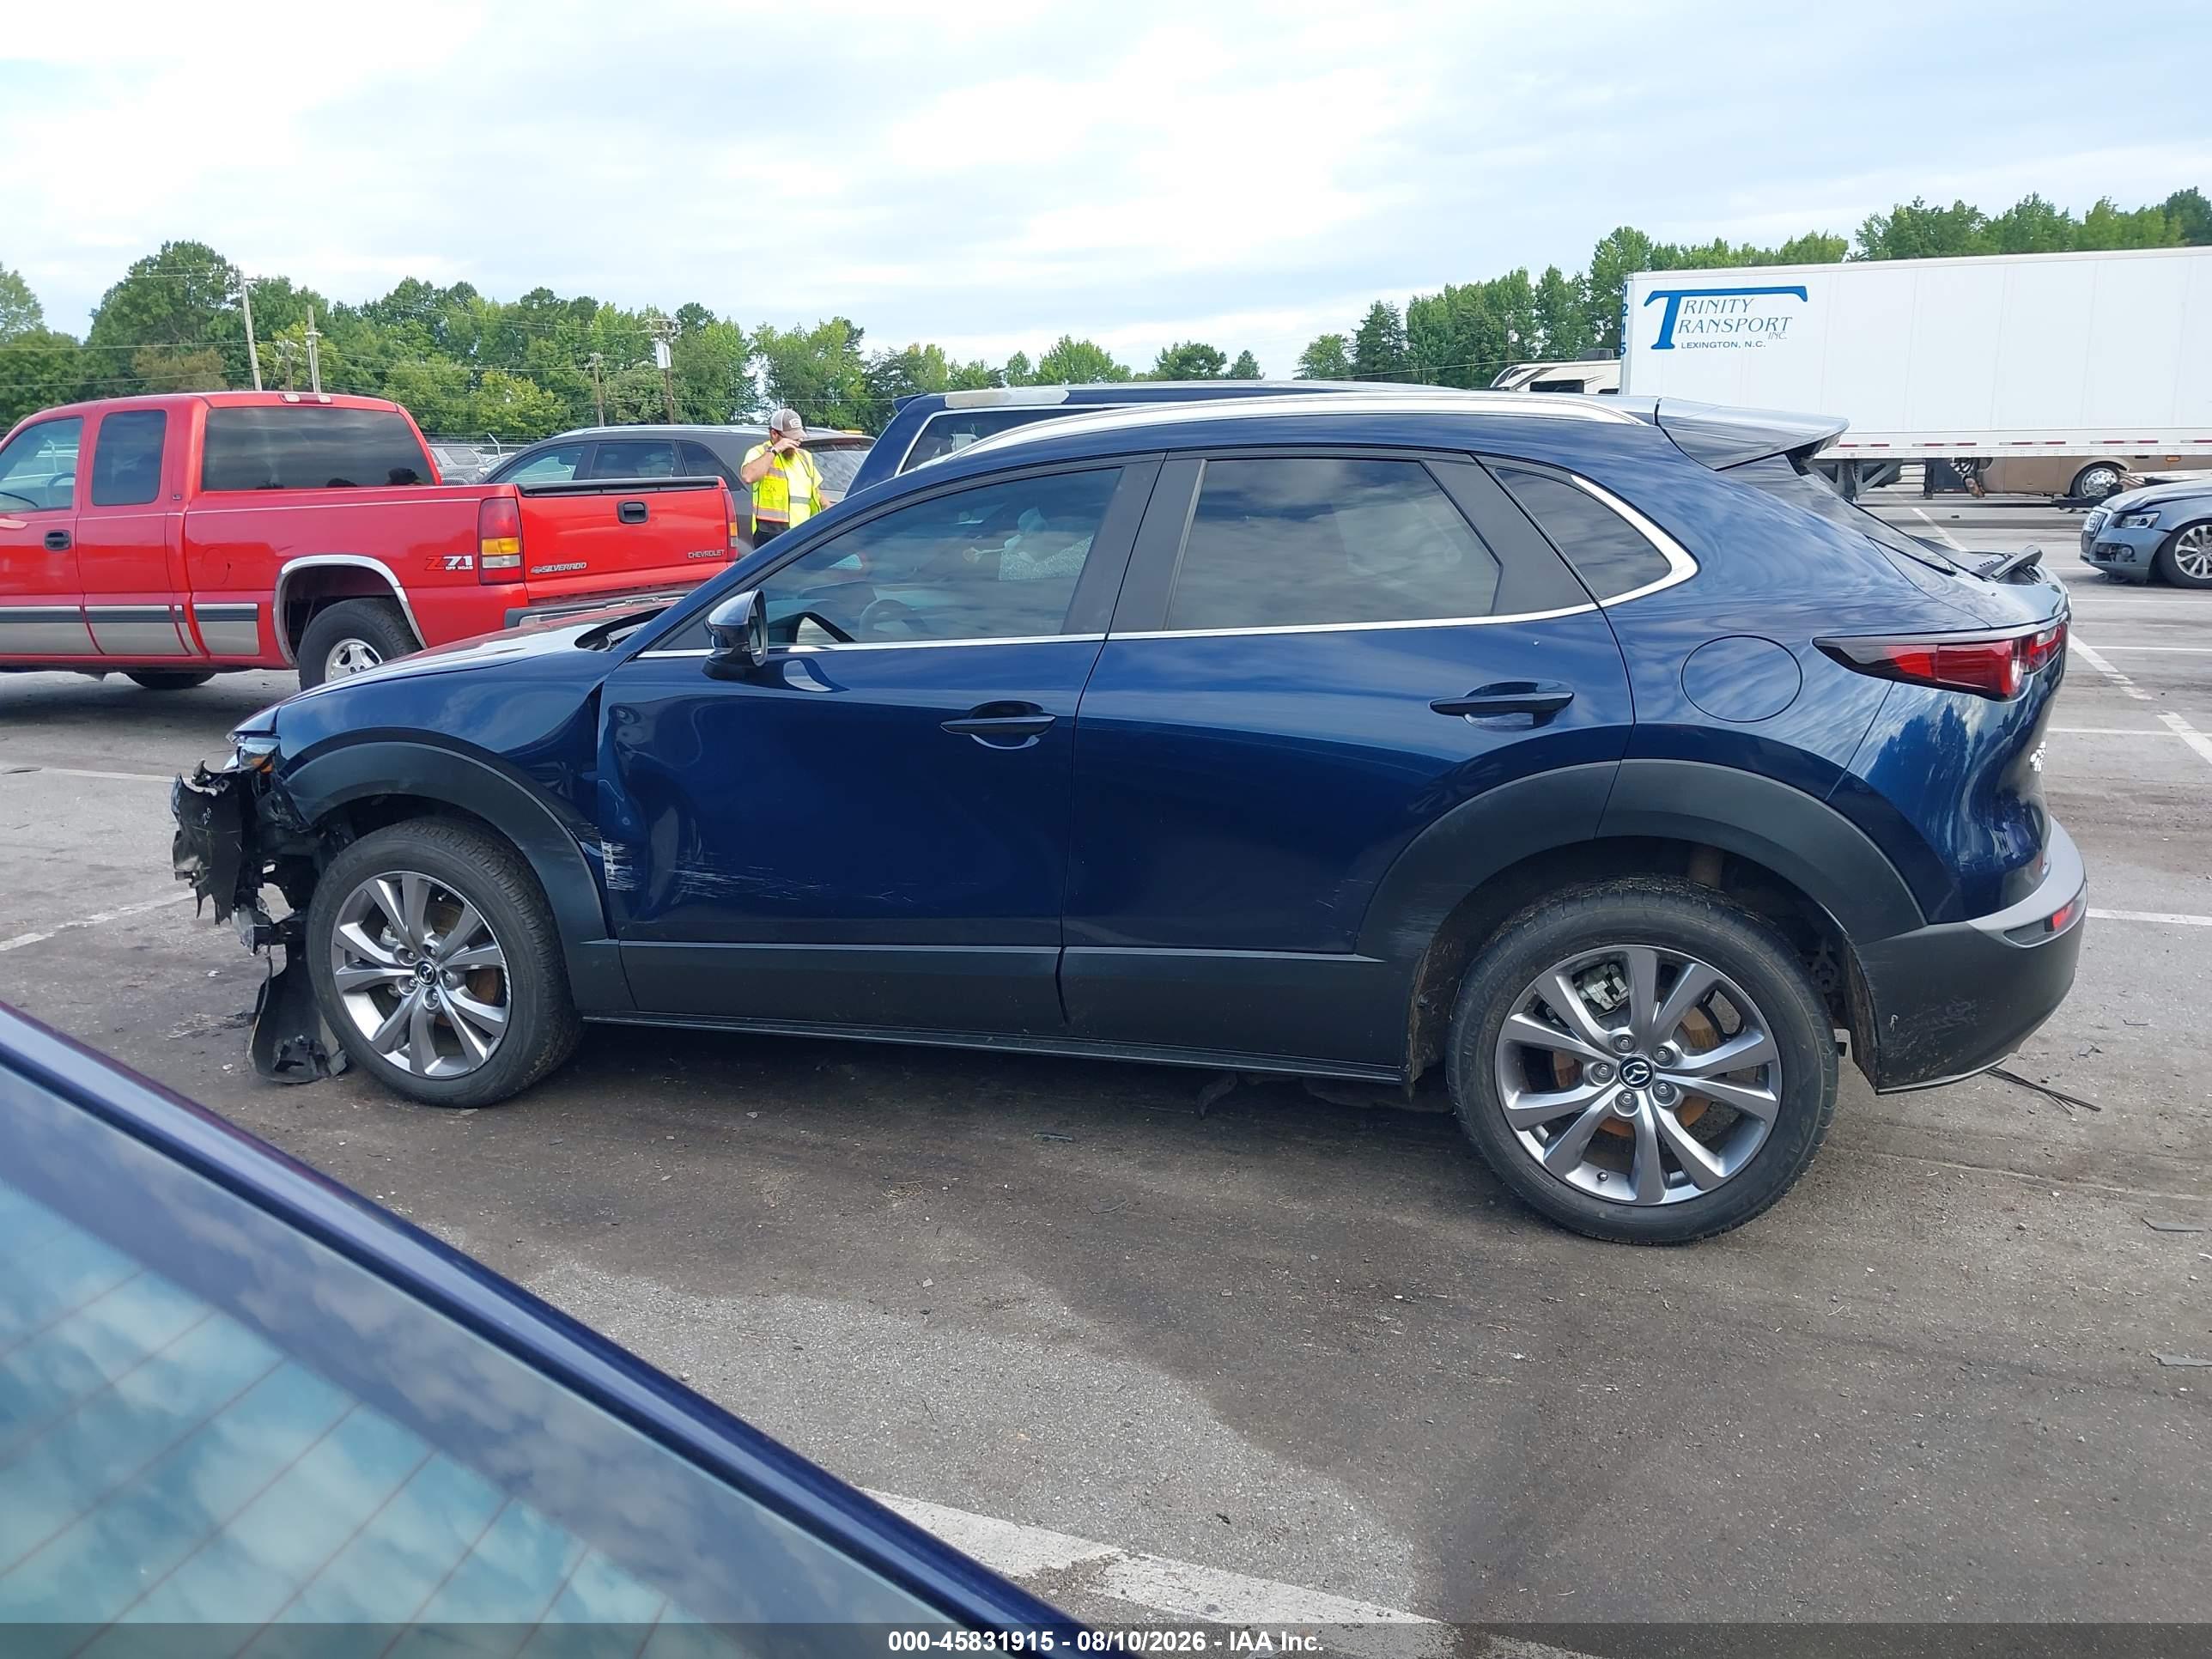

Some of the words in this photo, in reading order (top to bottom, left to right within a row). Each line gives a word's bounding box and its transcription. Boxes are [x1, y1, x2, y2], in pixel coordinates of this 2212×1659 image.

[1767, 331, 1788, 341] INC.
[1680, 340, 1741, 349] LEXINGTON,
[1744, 339, 1766, 349] N.C.
[688, 550, 725, 559] CHEVROLET
[425, 556, 473, 570] Z71
[541, 562, 587, 574] SILVERADO
